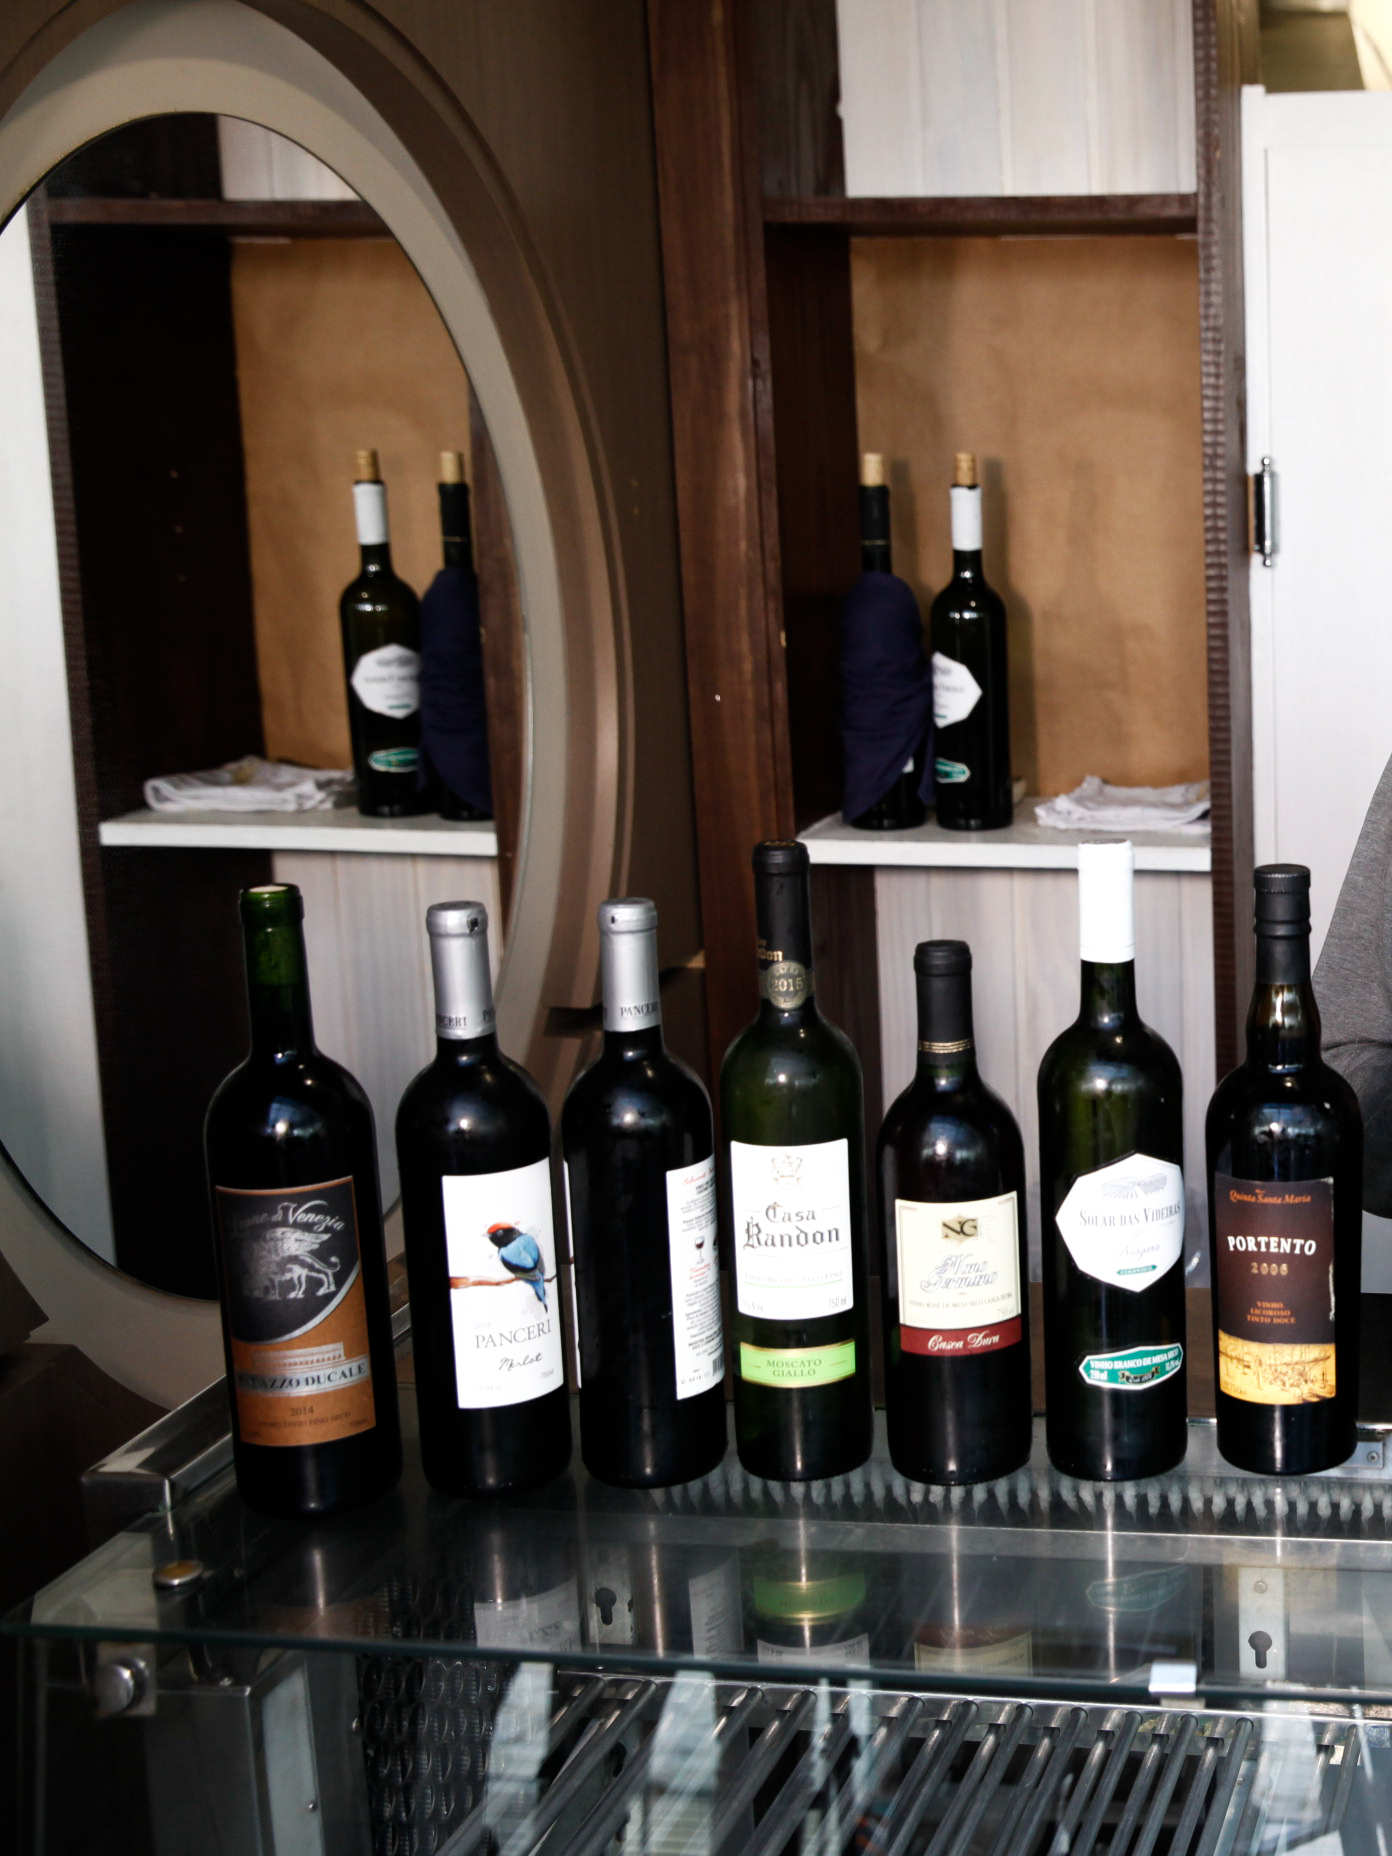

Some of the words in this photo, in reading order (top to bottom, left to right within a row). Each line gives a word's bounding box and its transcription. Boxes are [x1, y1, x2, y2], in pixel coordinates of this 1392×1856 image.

[771, 976, 805, 992] 2015
[1229, 1189, 1256, 1203] Quinta
[1255, 1188, 1283, 1204] Santa
[280, 1199, 346, 1233] Venezia
[764, 1200, 818, 1224] Casa
[742, 1215, 841, 1251] Randon
[941, 1217, 979, 1239] NG
[1226, 1234, 1317, 1256] PORTENTO
[1256, 1300, 1284, 1309] VINHO
[1246, 1314, 1272, 1324] TINTO
[1272, 1315, 1297, 1324] DOCE
[474, 1318, 552, 1349] PANCERI
[497, 1351, 544, 1372] Merlot
[766, 1358, 822, 1369] MOSCATO
[1089, 1359, 1113, 1370] VINHO
[1113, 1358, 1143, 1370] BRANCO
[1143, 1356, 1152, 1365] DE
[1152, 1353, 1167, 1364] MESA
[304, 1361, 367, 1388] DUCALE
[772, 1368, 816, 1378] GIALLO
[289, 1405, 315, 1418] 2014
